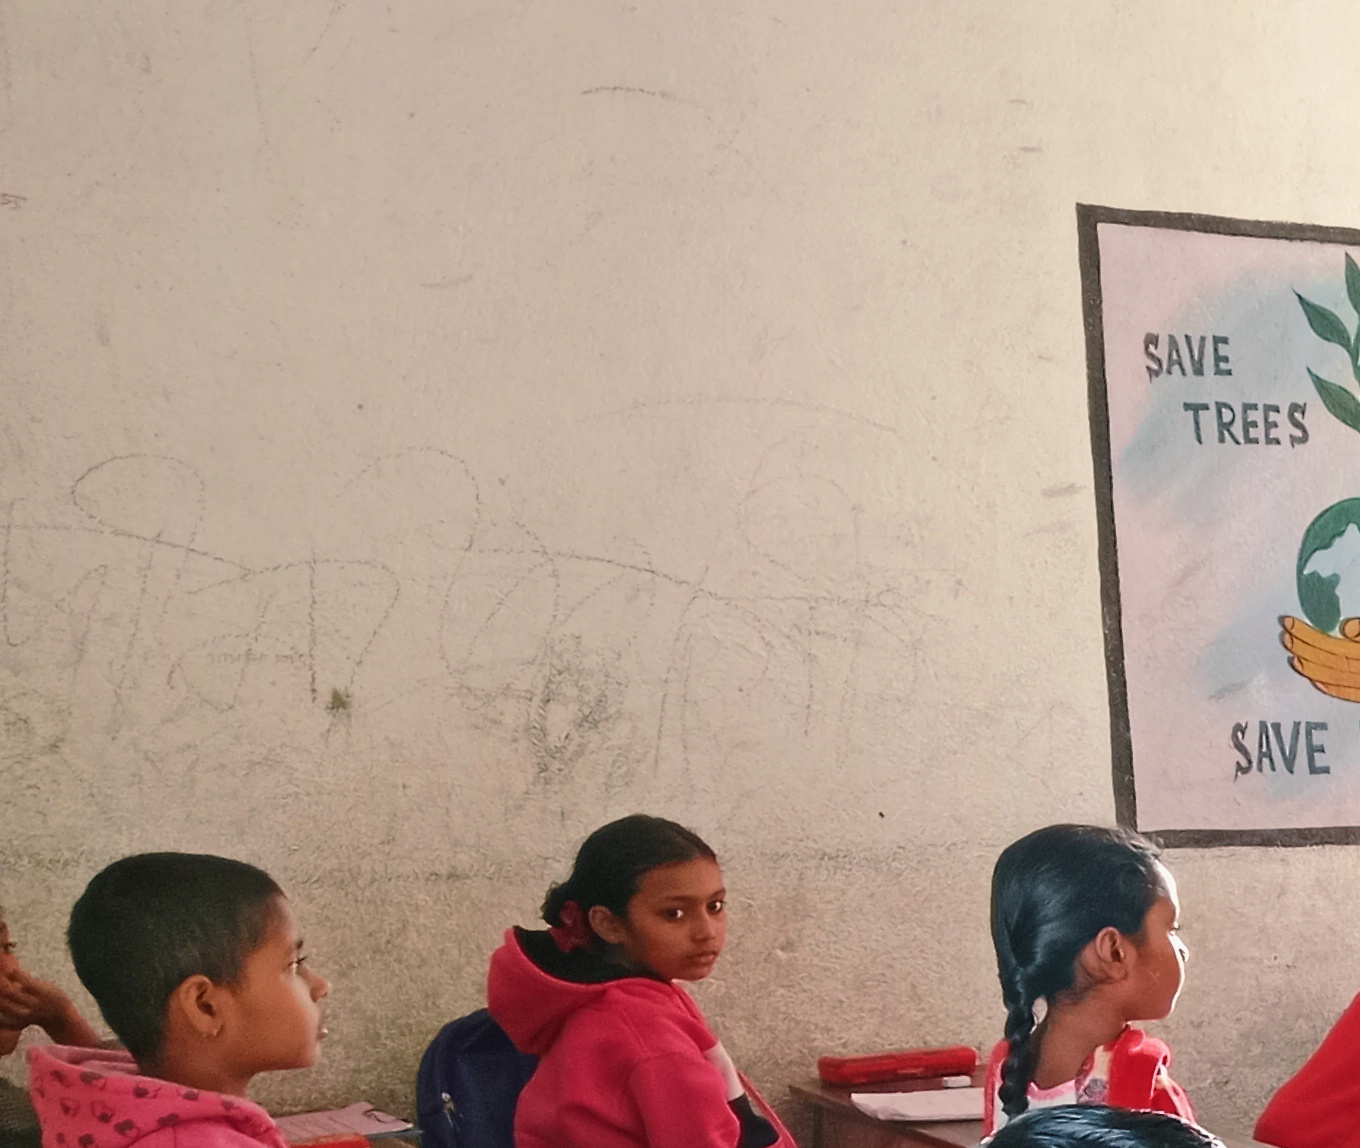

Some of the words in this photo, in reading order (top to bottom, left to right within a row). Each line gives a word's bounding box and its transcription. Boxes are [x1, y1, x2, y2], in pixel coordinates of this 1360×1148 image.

[1143, 331, 1232, 381] SAVE
[1184, 402, 1310, 449] TREES
[1230, 719, 1330, 782] SAVE
